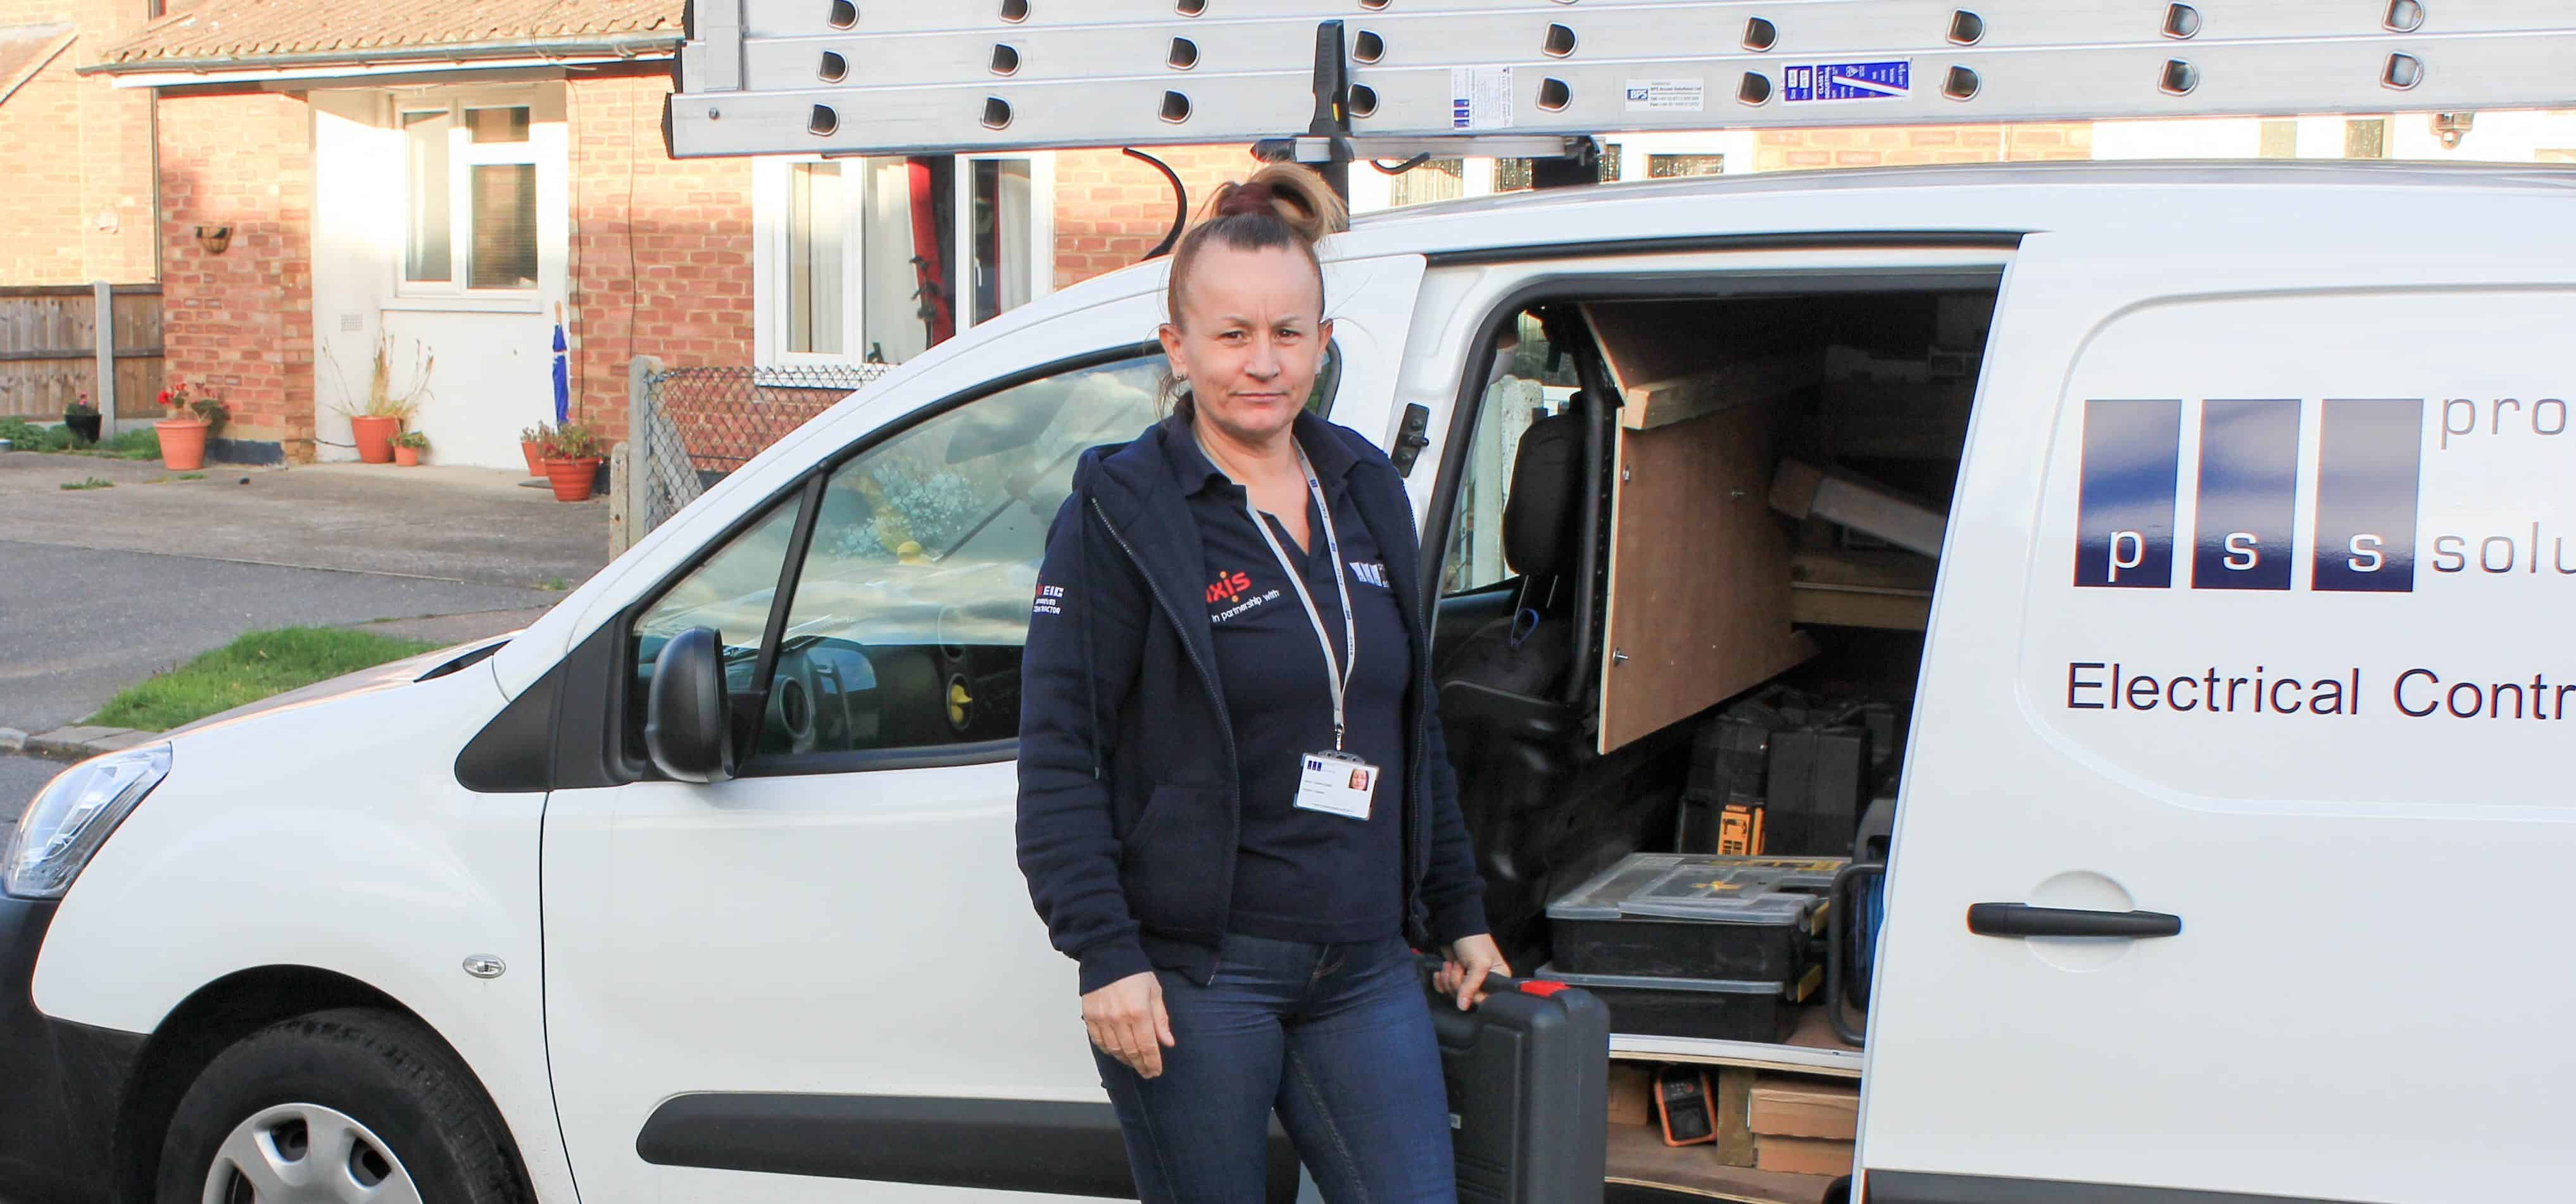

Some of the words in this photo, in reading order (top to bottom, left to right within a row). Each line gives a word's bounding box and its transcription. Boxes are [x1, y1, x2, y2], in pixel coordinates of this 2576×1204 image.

[2441, 398, 2567, 450] pro
[1036, 584, 1064, 598] EIC
[1221, 596, 1262, 622] partnership
[1262, 589, 1280, 602] with
[2067, 662, 2359, 715] Electrical
[2393, 668, 2576, 720] Contr
